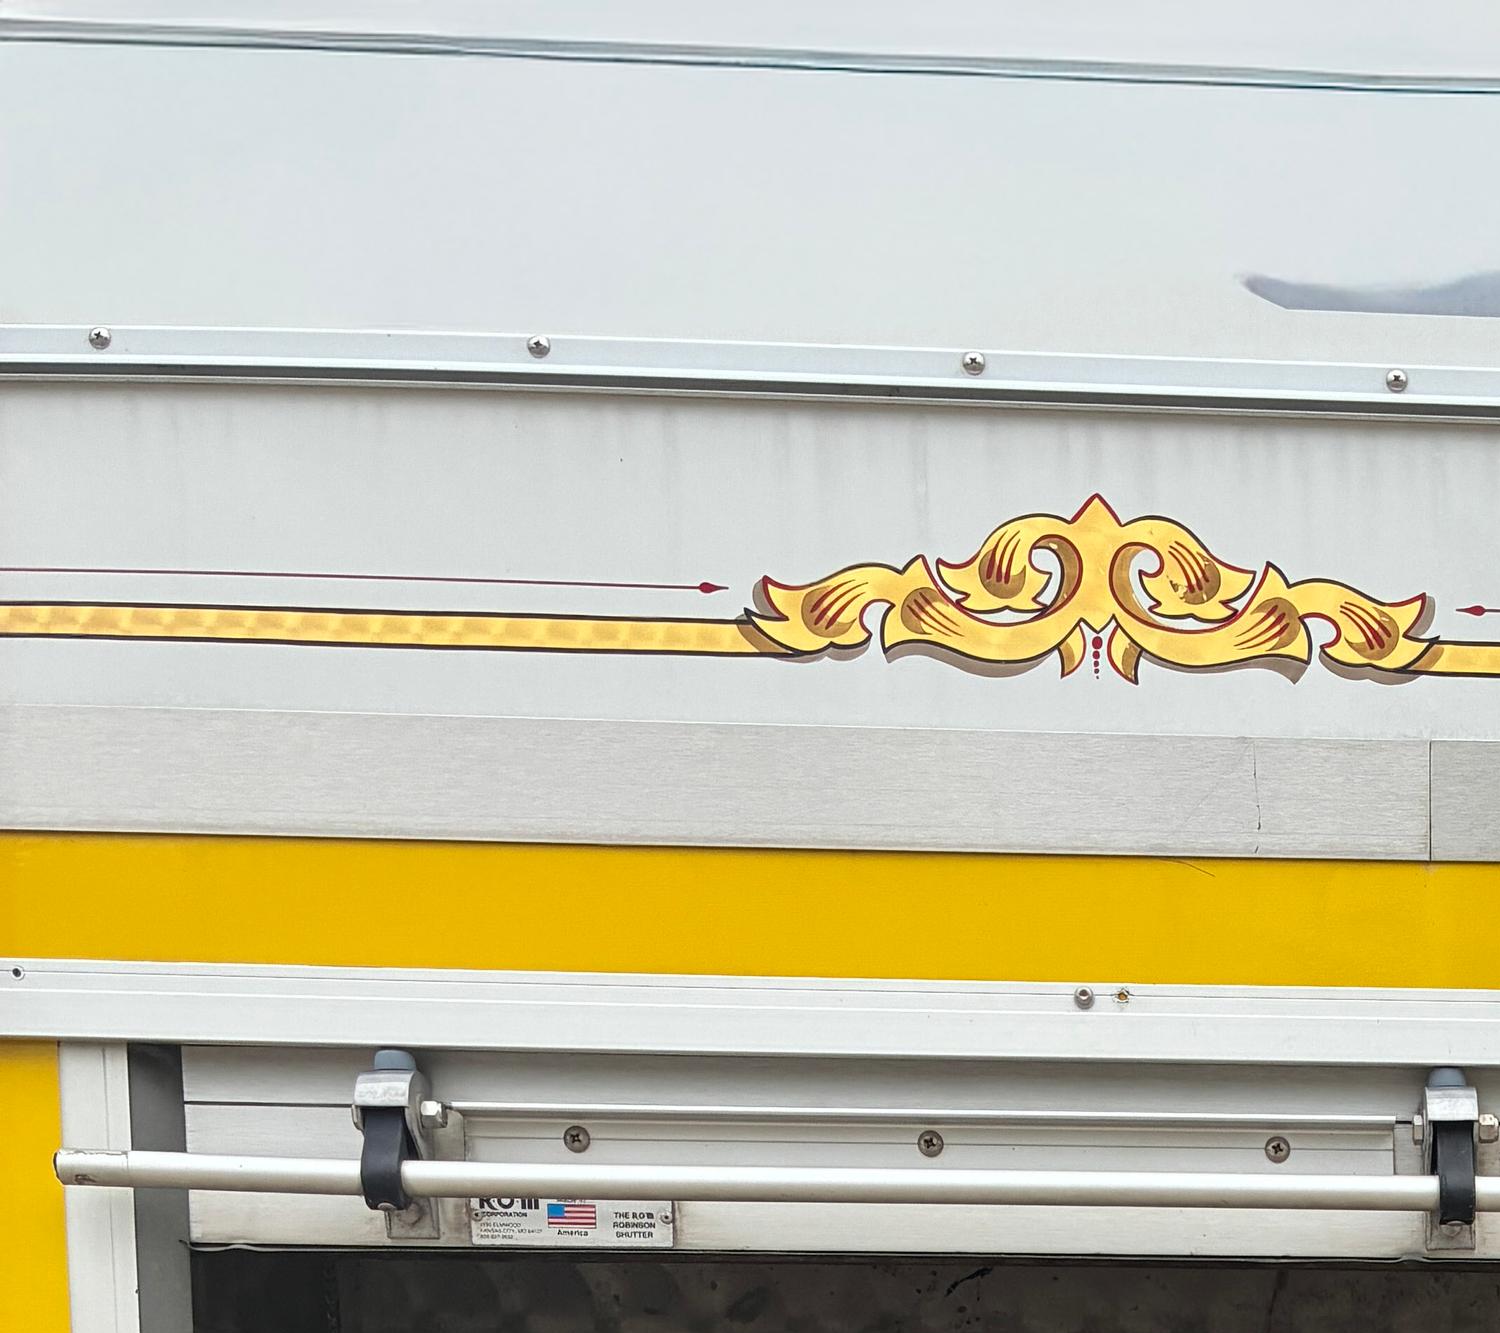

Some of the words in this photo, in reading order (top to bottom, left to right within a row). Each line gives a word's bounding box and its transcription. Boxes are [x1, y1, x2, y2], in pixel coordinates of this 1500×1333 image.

[613, 1211, 630, 1219] THE
[613, 1221, 656, 1229] ROBINSON
[557, 1229, 589, 1237] America
[615, 1231, 654, 1239] SHUTTER
